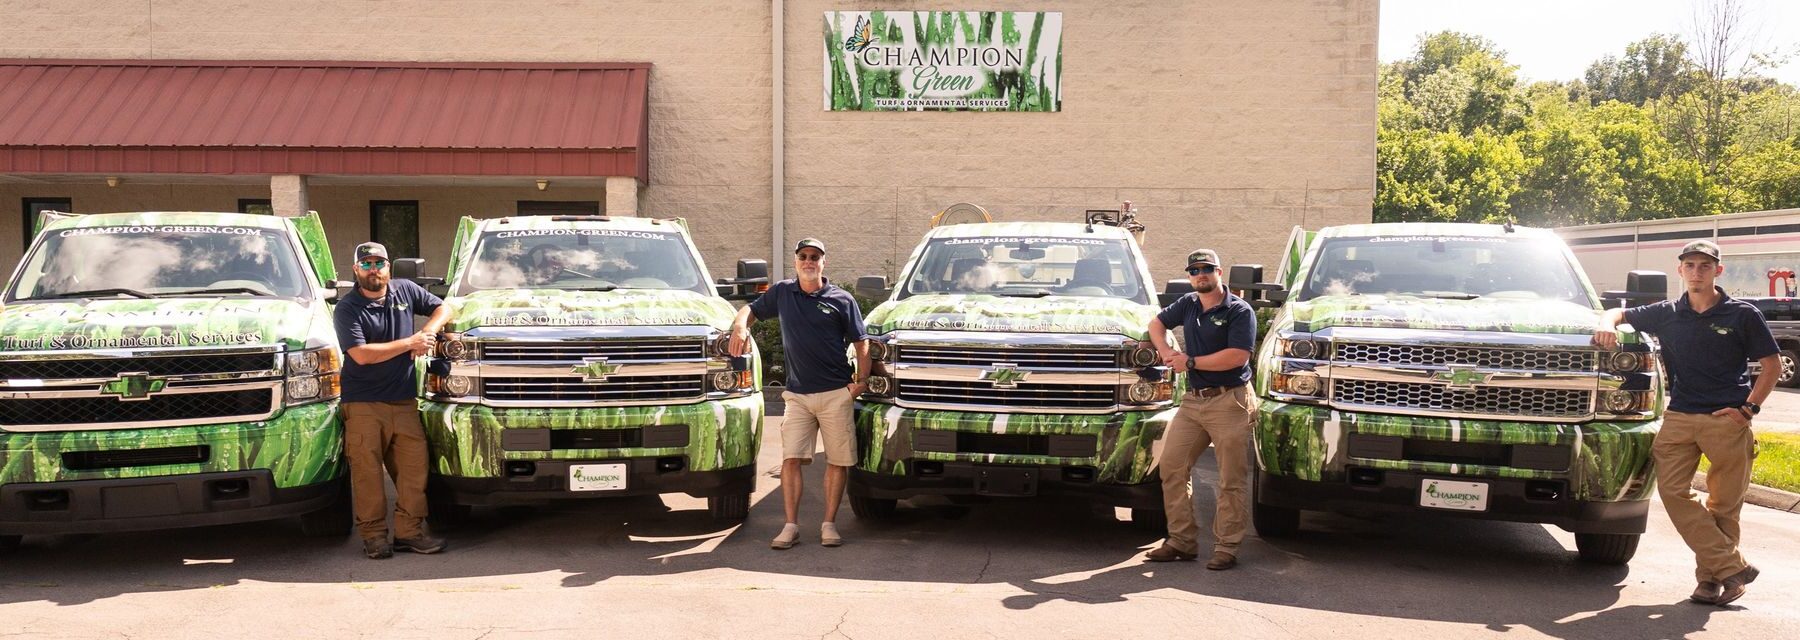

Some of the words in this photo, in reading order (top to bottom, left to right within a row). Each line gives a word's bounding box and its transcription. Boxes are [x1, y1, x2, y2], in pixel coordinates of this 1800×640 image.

[863, 47, 1023, 67] CHAMPION
[908, 66, 975, 99] Green
[907, 99, 968, 107] ORNAMENTAL
[59, 225, 262, 238] CHAMPION-GREEN.COM
[496, 229, 665, 241] CHAMPION-GREEN.COM
[944, 236, 1106, 247] champion-green.com
[1369, 235, 1507, 244] champion-green.com
[4, 335, 44, 350] Turf
[50, 336, 66, 349] &
[72, 332, 182, 349] Ornamental
[190, 330, 262, 344] Services
[1430, 491, 1480, 501] CHAMPION
